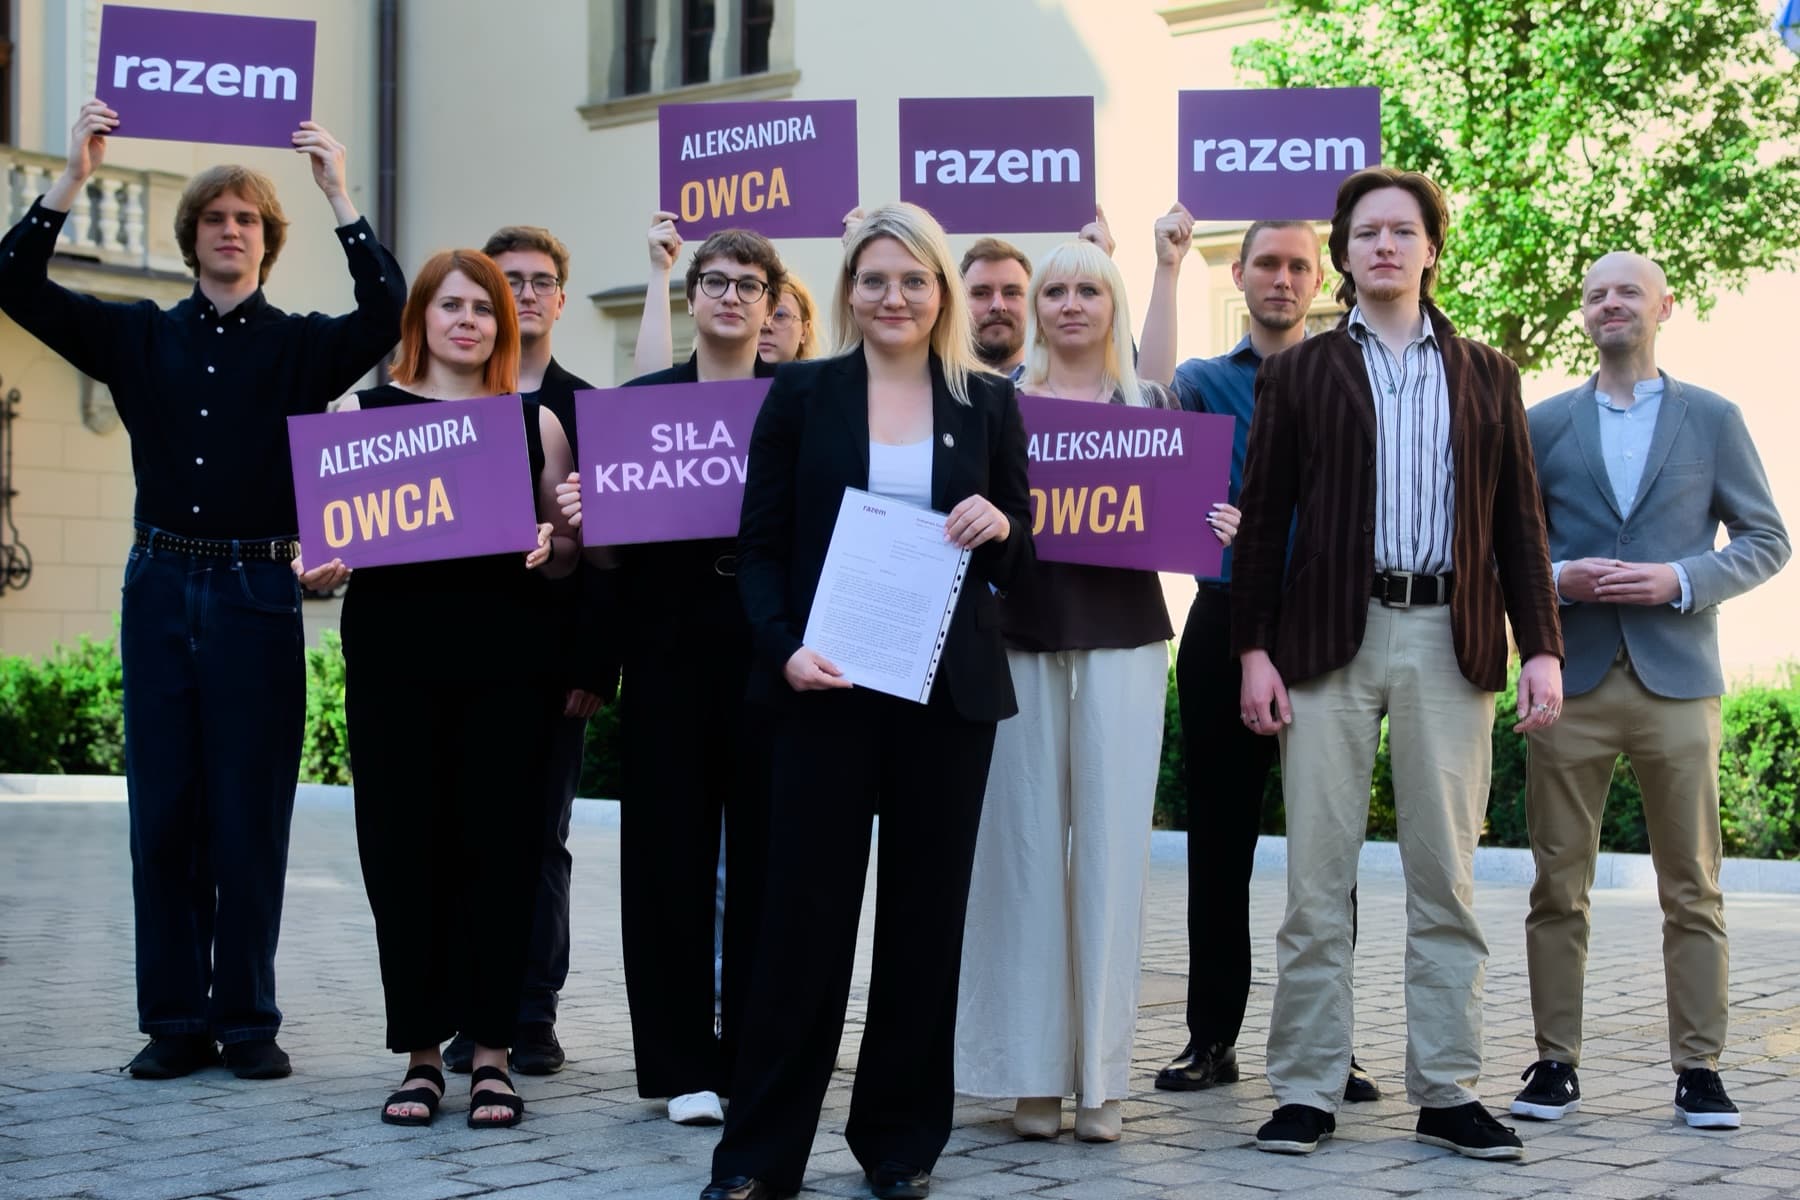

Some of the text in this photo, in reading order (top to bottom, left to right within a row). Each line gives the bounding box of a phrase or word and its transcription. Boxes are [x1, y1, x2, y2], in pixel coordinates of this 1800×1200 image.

[113, 55, 298, 101] razem
[680, 114, 817, 161] ALEKSANDRA
[1192, 136, 1365, 174] razem
[914, 147, 1081, 185] razem
[680, 167, 791, 223] OWCA
[319, 415, 478, 478] ALEKSANDRA
[651, 420, 735, 453] SIŁA
[1028, 427, 1184, 462] ALEKSANDRA
[323, 477, 455, 549] OWCA
[863, 505, 887, 517] razem
